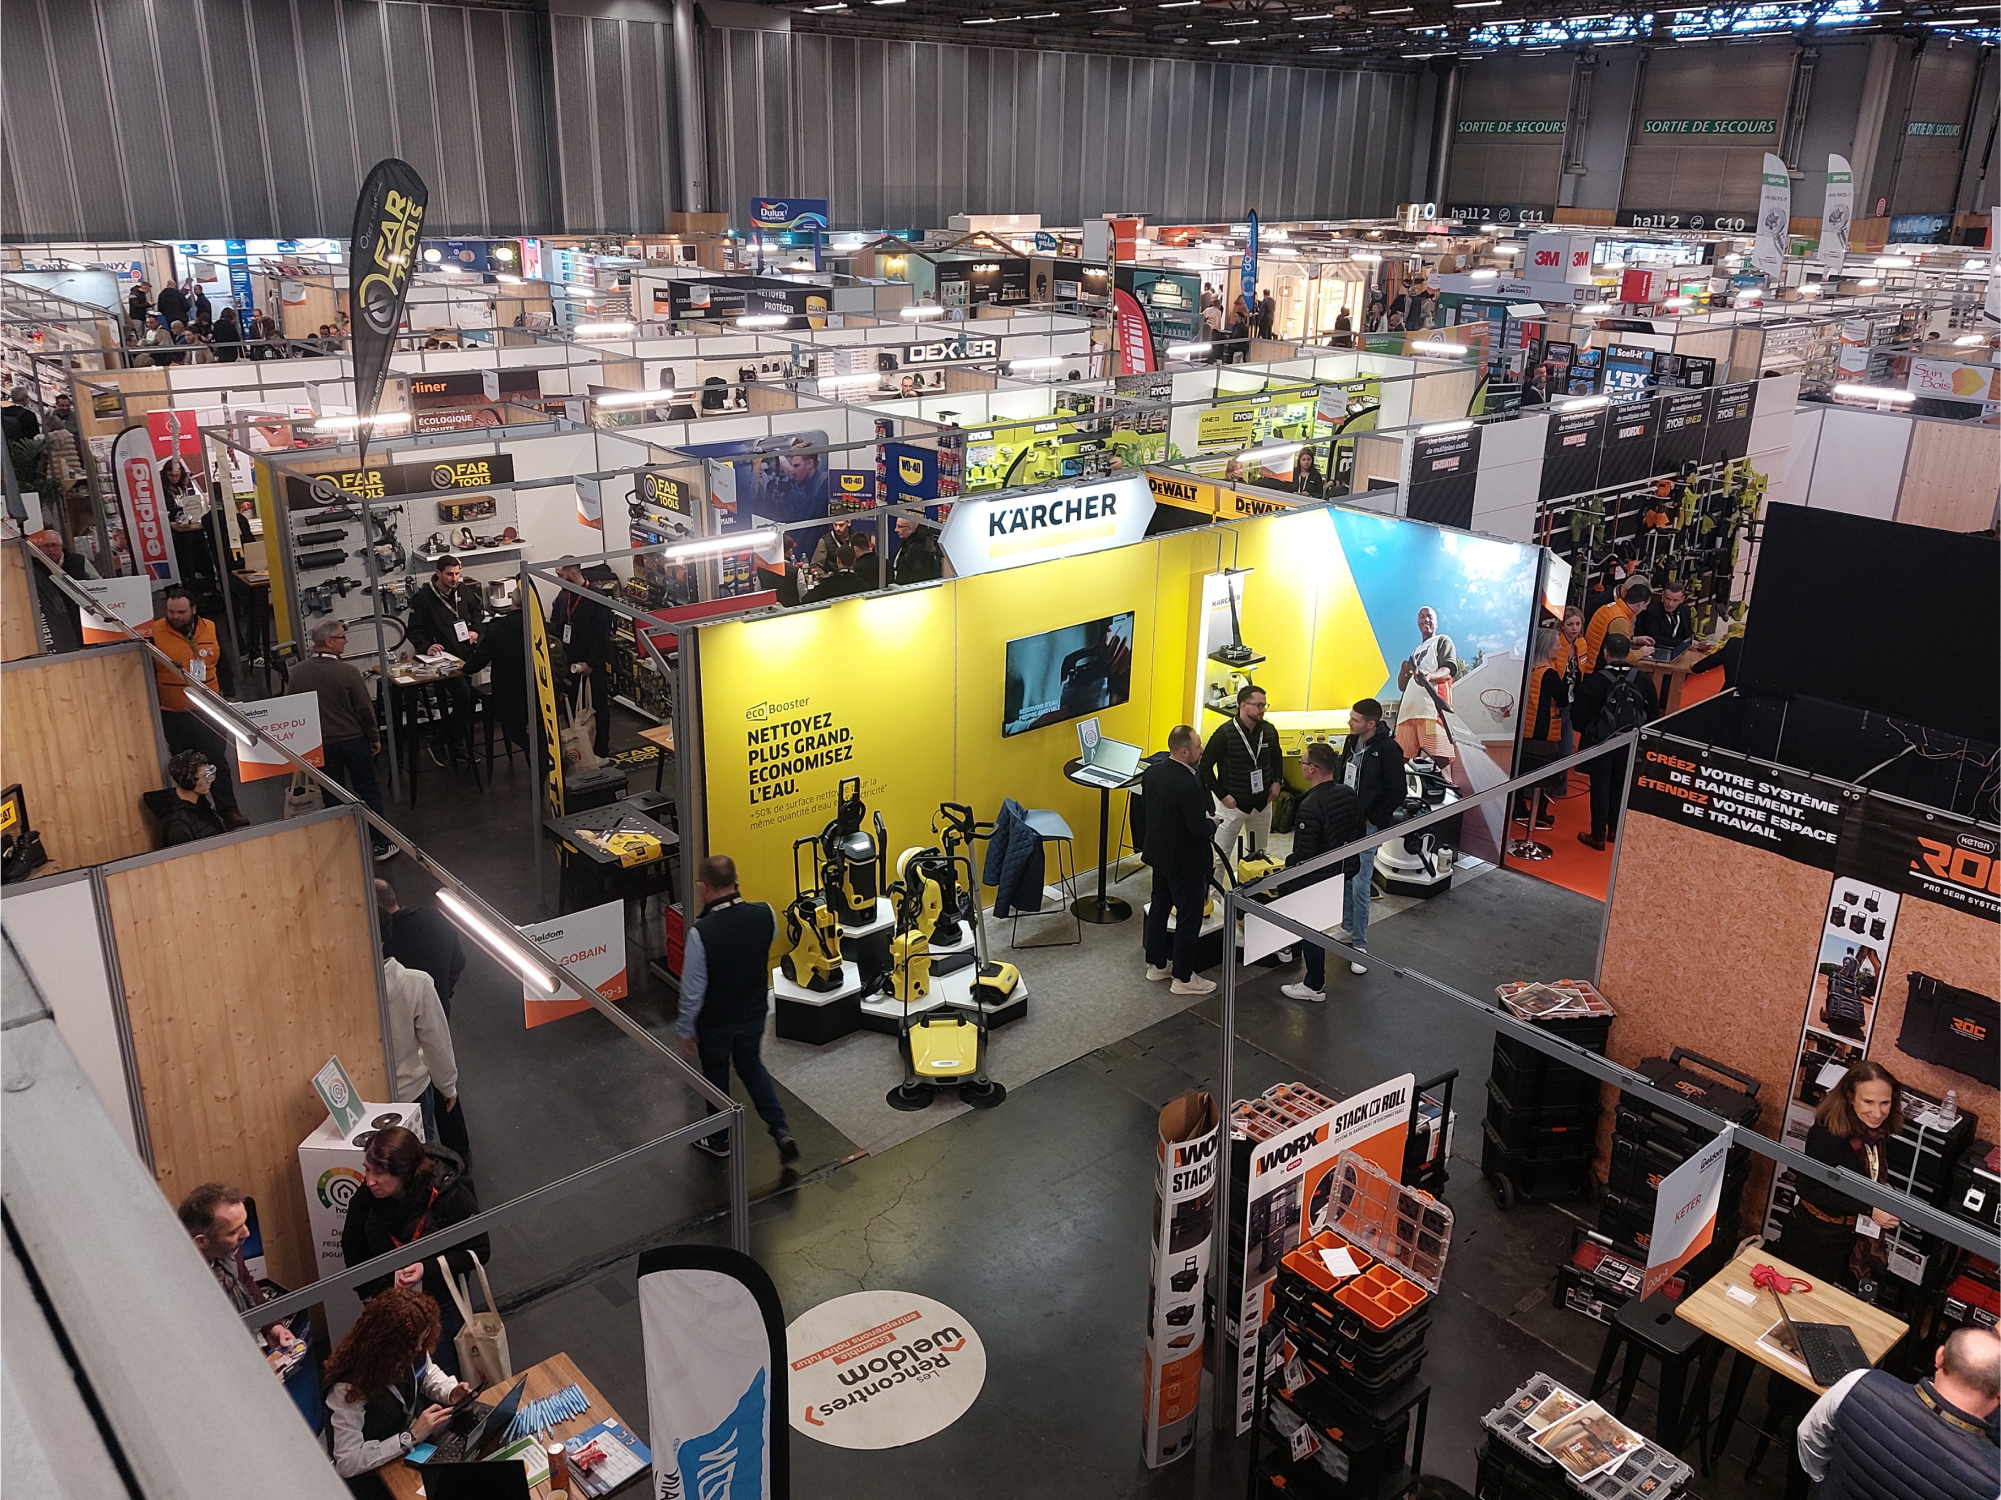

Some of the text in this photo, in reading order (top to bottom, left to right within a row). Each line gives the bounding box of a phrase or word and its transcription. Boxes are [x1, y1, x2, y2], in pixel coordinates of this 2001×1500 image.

[1457, 120, 1566, 133] SORTIE DE SECOURS
[1644, 119, 1776, 133] SORTIE DE SECOURS
[760, 208, 786, 217] Dulux
[1451, 207, 1545, 223] hall 2 C11
[1632, 214, 1746, 232] hall 2 C10
[373, 189, 407, 270] FAR
[1534, 250, 1560, 267] 3M
[1572, 251, 1589, 268] 3M
[1155, 281, 1178, 293] IMPACT
[909, 338, 998, 363] DEXER
[1912, 363, 1943, 378] Sun
[410, 381, 447, 394] rliner
[1150, 386, 1171, 397] RYOBI
[1920, 376, 1951, 390] Bois
[418, 412, 473, 426] ÉCOLOGIQUE
[456, 461, 490, 476] FAR
[901, 458, 921, 474] WD-40
[341, 470, 382, 486] FAR
[458, 475, 491, 488] TOOLS
[657, 478, 678, 496] FAR
[842, 476, 863, 485] WD-40
[131, 463, 162, 557] edding
[659, 495, 680, 510] TOOLS
[988, 492, 1117, 537] KÄRCHER
[107, 601, 127, 610] GMT
[745, 697, 811, 720] eco Booster
[270, 719, 306, 732] EXP DU
[747, 712, 832, 746] NETTOYEZ
[748, 727, 854, 766] PLUS GRAND.
[749, 745, 853, 786] ECONOMISEZ
[750, 778, 800, 805] L'EAU.
[1645, 751, 1840, 816] CRÉEZ VOTRE SYSTÈME
[750, 807, 772, 819] +50%
[774, 804, 784, 814] de
[786, 796, 814, 811] surface
[816, 783, 850, 802] nettoye
[1669, 770, 1806, 821] DE RANGEMENT.
[750, 802, 832, 831] même quantité d'eau
[1637, 775, 1839, 845] ÉTENDEZ VOTRE ESPACE
[1682, 802, 1783, 843] DE TRAVAIL.
[1922, 882, 1966, 902] PRO GEAR
[560, 943, 608, 967] GOBAIN
[1950, 1016, 1987, 1039] ROC
[1334, 1087, 1406, 1135] STACK ROLL
[1259, 1127, 1320, 1176] WORX
[1674, 1193, 1702, 1224] KETER
[795, 1312, 918, 1369] entreprenons notre futur
[837, 1334, 892, 1361] Ensemble,
[837, 1326, 963, 1386] weldom
[819, 1352, 952, 1417] Rencontres
[915, 1369, 940, 1384] Les
